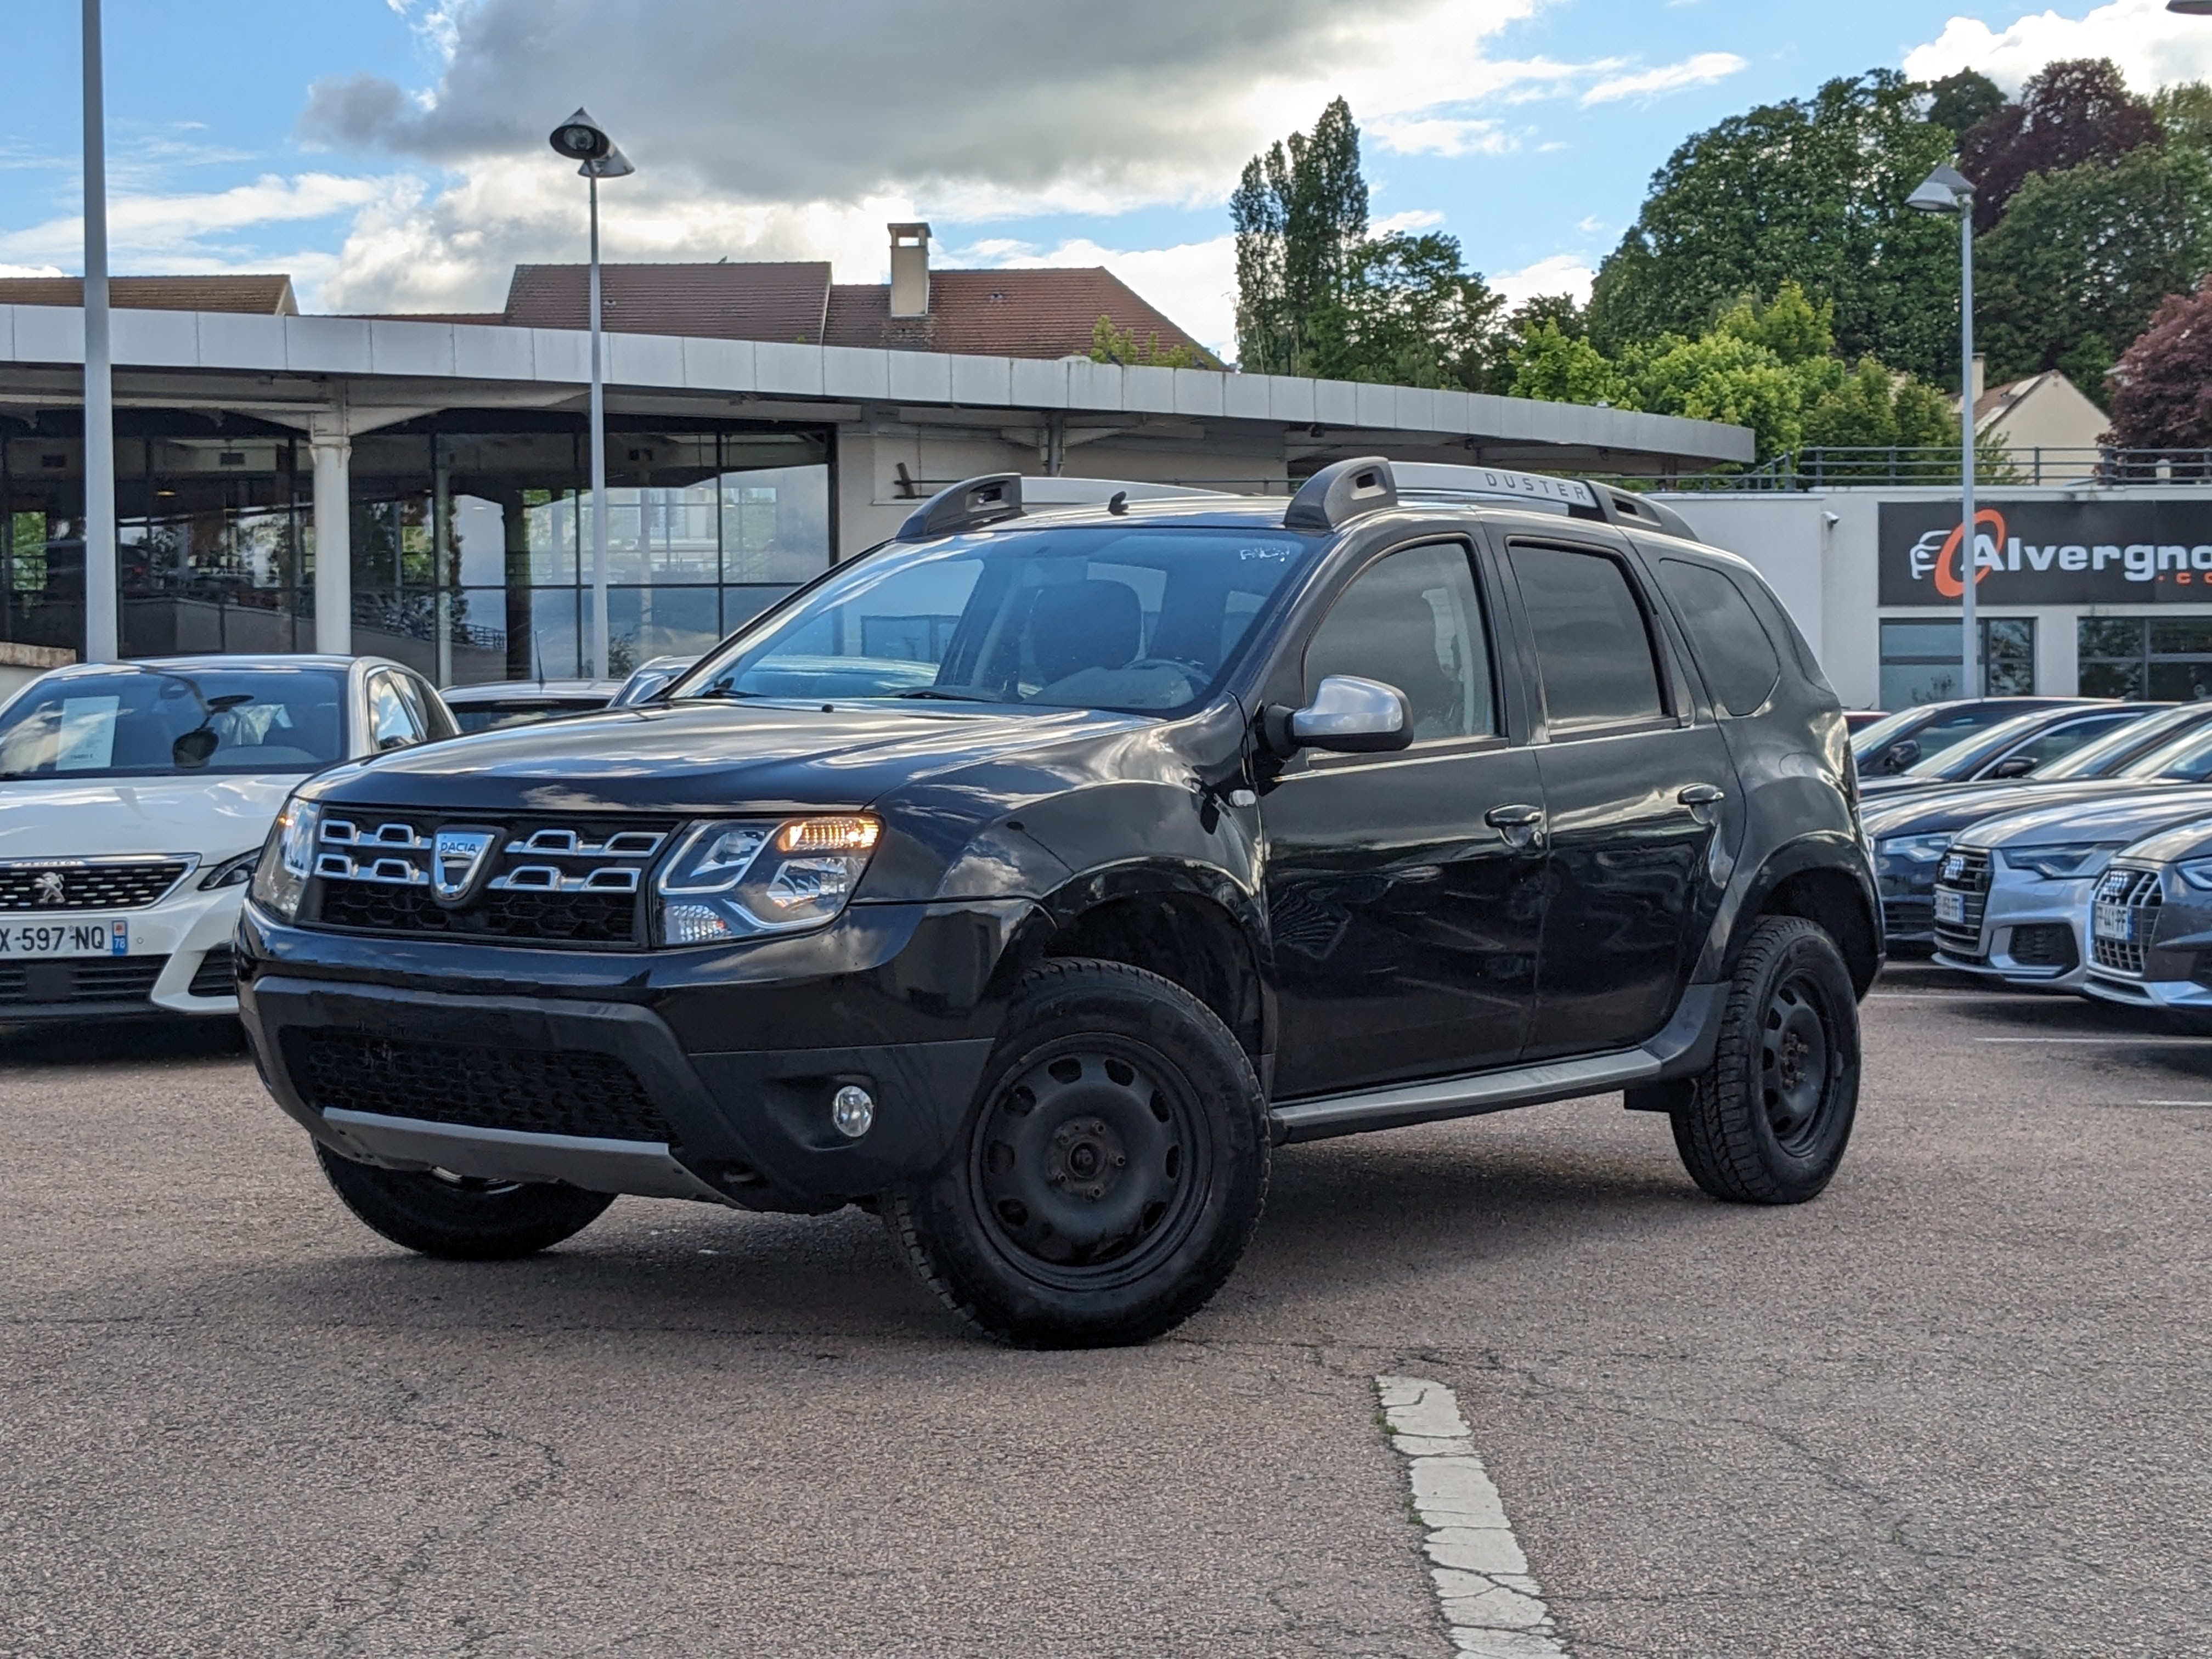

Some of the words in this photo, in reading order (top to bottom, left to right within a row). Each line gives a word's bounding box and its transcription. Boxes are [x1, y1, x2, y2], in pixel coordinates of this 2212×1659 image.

[1485, 472, 1587, 500] DUSTER
[441, 842, 476, 852] DACIA
[114, 938, 126, 949] 78
